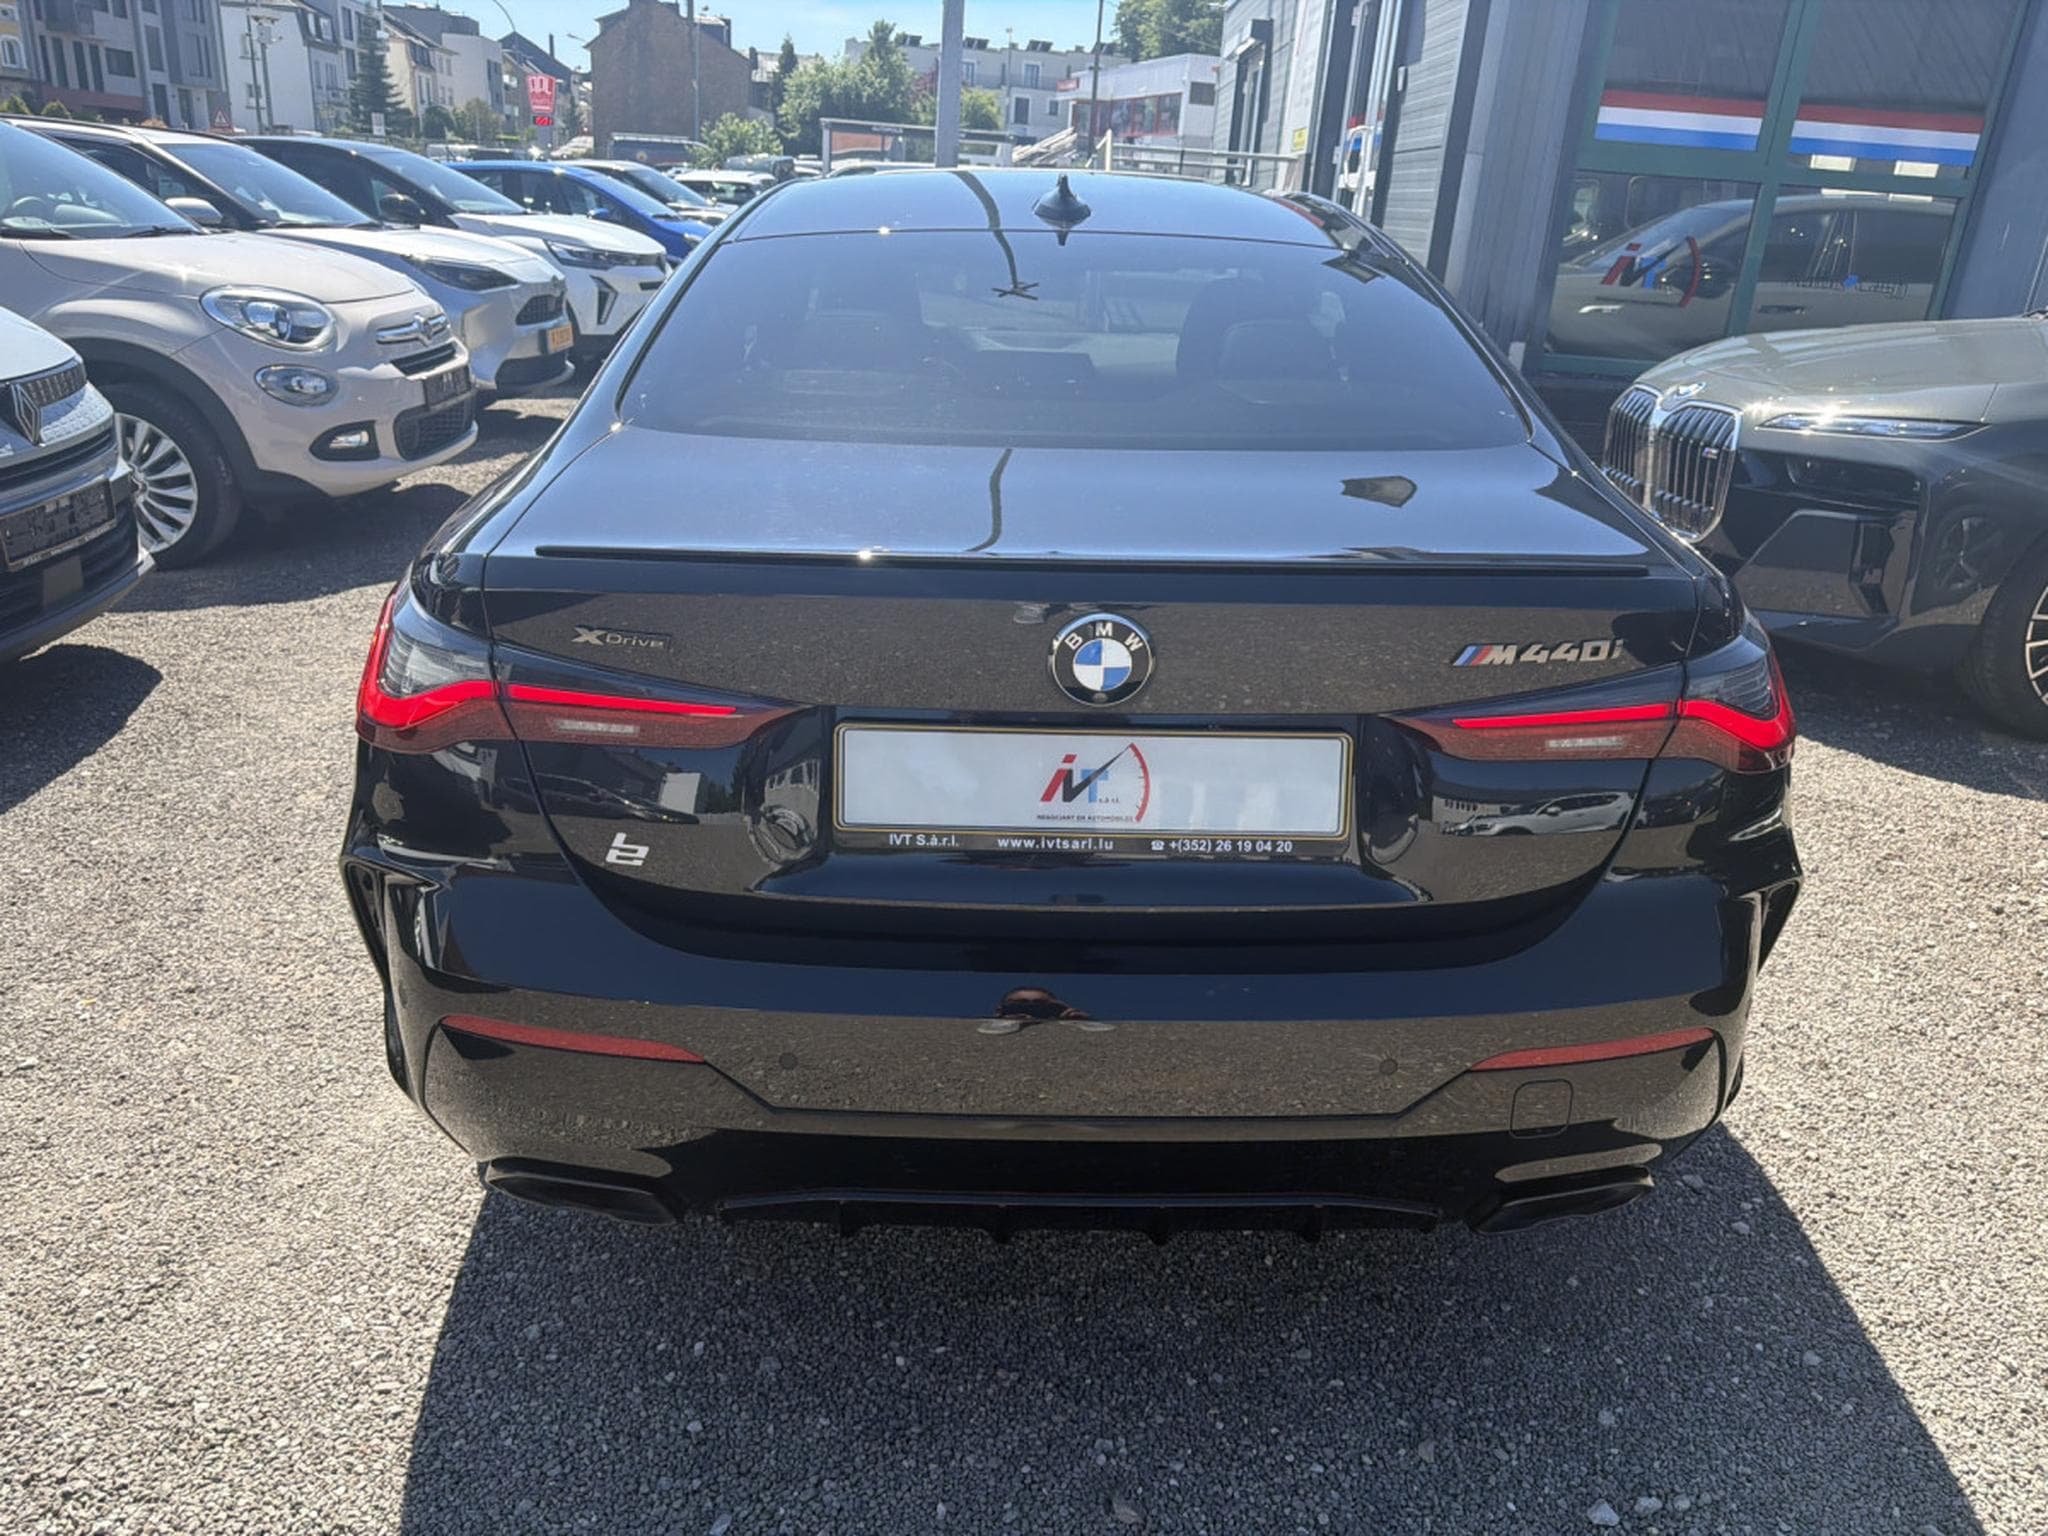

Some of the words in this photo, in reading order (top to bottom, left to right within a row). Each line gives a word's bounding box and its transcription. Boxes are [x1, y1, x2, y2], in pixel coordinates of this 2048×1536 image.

[1064, 621, 1144, 652] BMW
[889, 833, 913, 846] IVT
[997, 836, 1115, 851] www.ivtsarl.lu
[1168, 839, 1213, 854] +(352)
[1214, 840, 1233, 853] 26
[1236, 840, 1252, 853] 19
[1255, 841, 1273, 853] 04
[1276, 841, 1294, 854] 20
